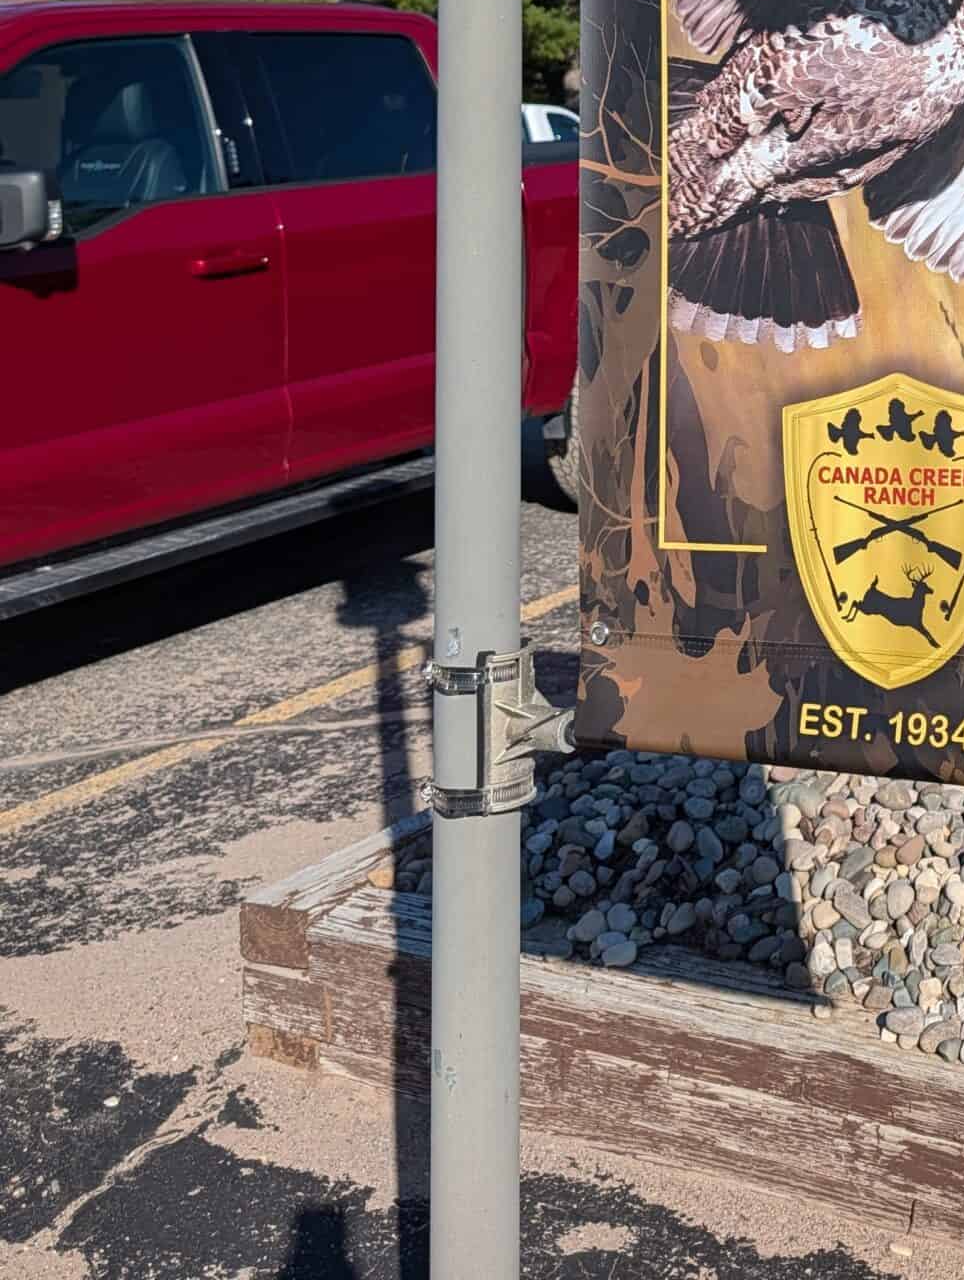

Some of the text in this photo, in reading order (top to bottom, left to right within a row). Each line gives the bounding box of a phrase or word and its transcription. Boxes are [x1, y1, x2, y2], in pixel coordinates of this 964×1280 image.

[818, 467, 902, 485] CANADA
[864, 487, 935, 506] RANCH
[799, 703, 871, 742] EST.
